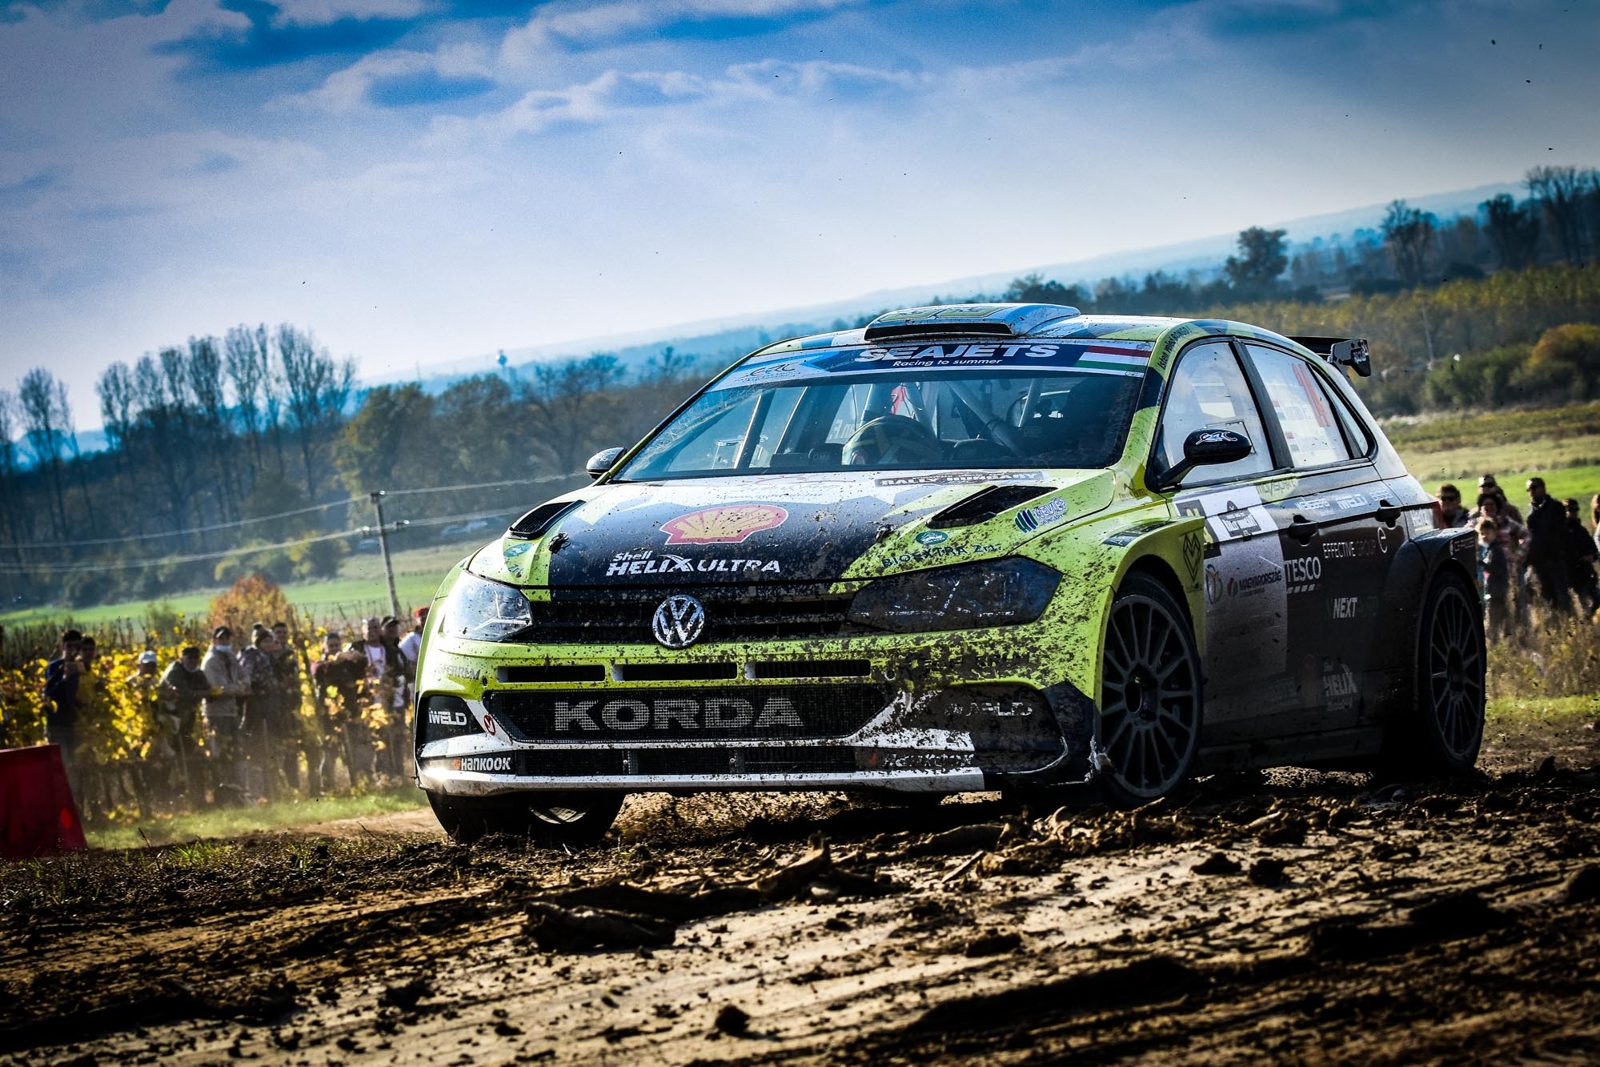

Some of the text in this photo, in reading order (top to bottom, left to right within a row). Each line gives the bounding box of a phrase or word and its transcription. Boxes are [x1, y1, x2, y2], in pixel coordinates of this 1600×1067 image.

[854, 344, 1061, 363] SEAJETS
[892, 360, 934, 368] Racing
[952, 358, 1003, 366] summer
[615, 550, 652, 562] Shell
[1322, 540, 1357, 560] EFFECTIVE
[605, 554, 781, 577] HELIX ULTRA
[1284, 556, 1322, 583] TESCO
[1333, 597, 1358, 619] NEXT
[428, 708, 468, 726] iWELD
[554, 697, 804, 731] KORDA
